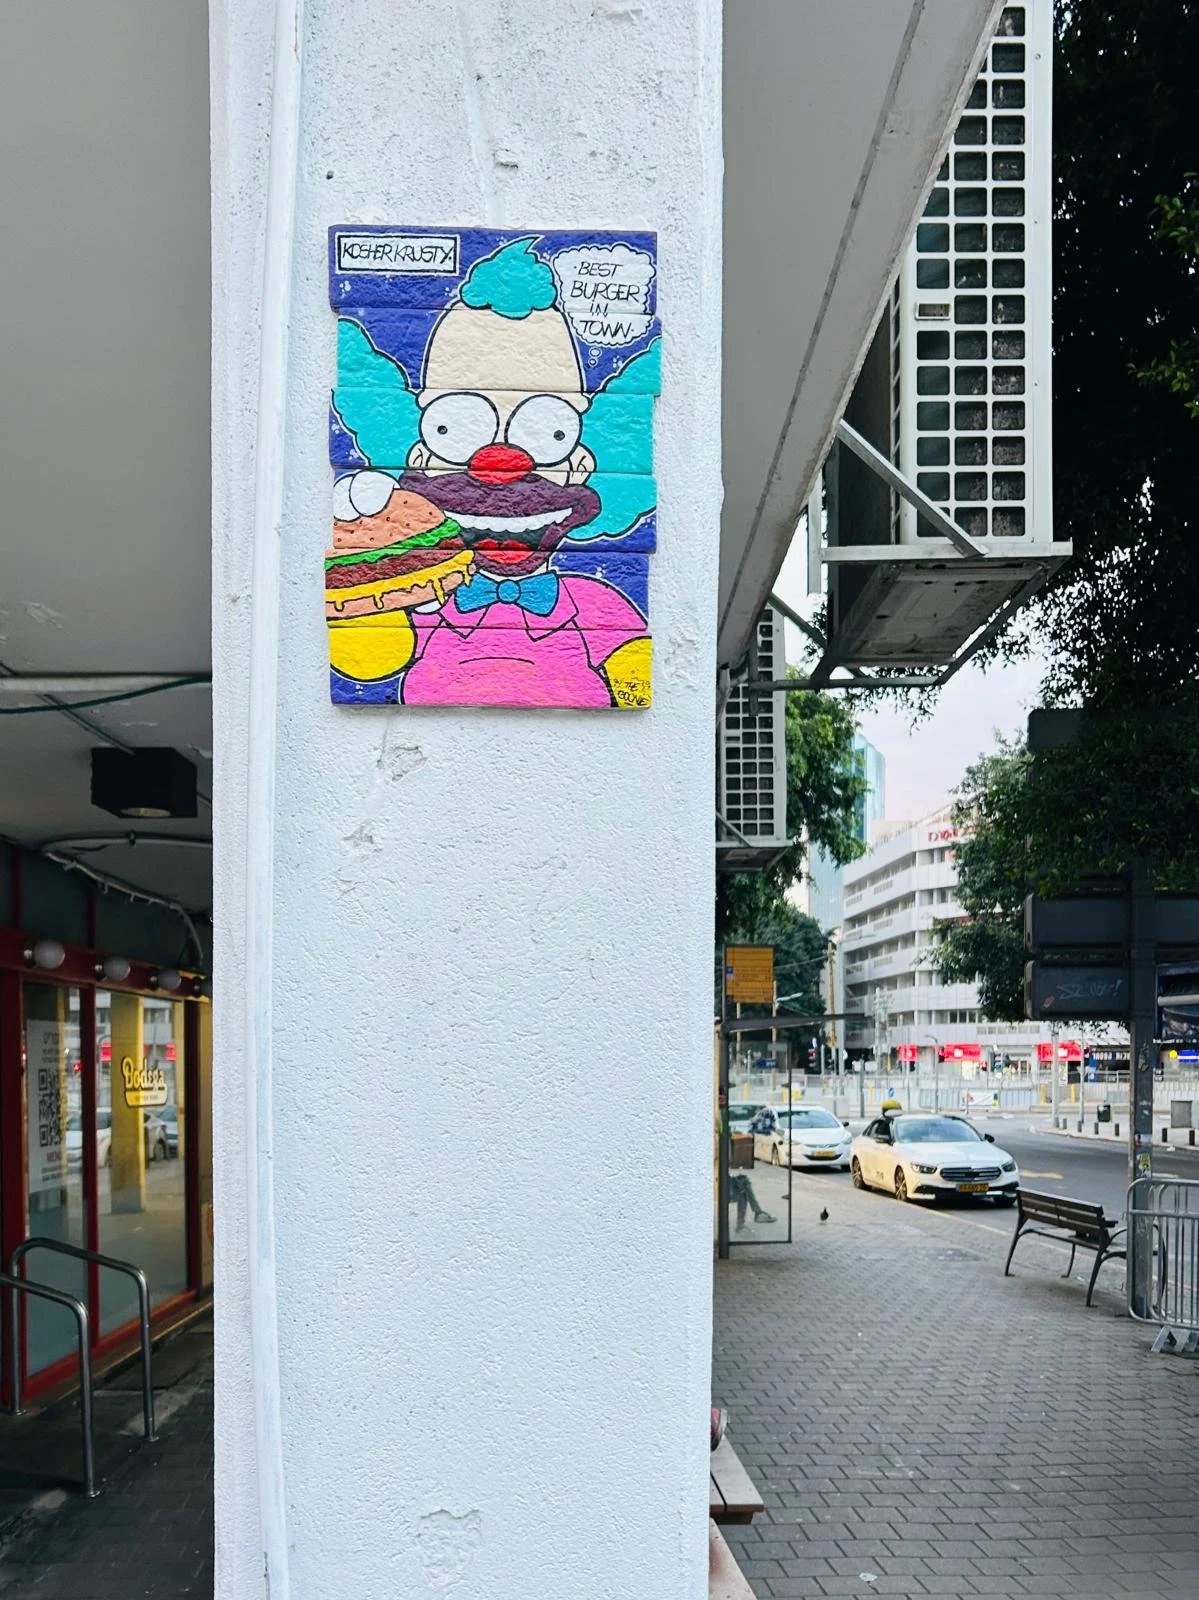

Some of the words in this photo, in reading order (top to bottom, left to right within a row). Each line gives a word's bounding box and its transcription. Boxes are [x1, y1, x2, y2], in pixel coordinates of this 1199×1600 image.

[342, 242, 393, 262] KOSHER
[570, 280, 640, 303] BURGER
[590, 303, 609, 318] IN
